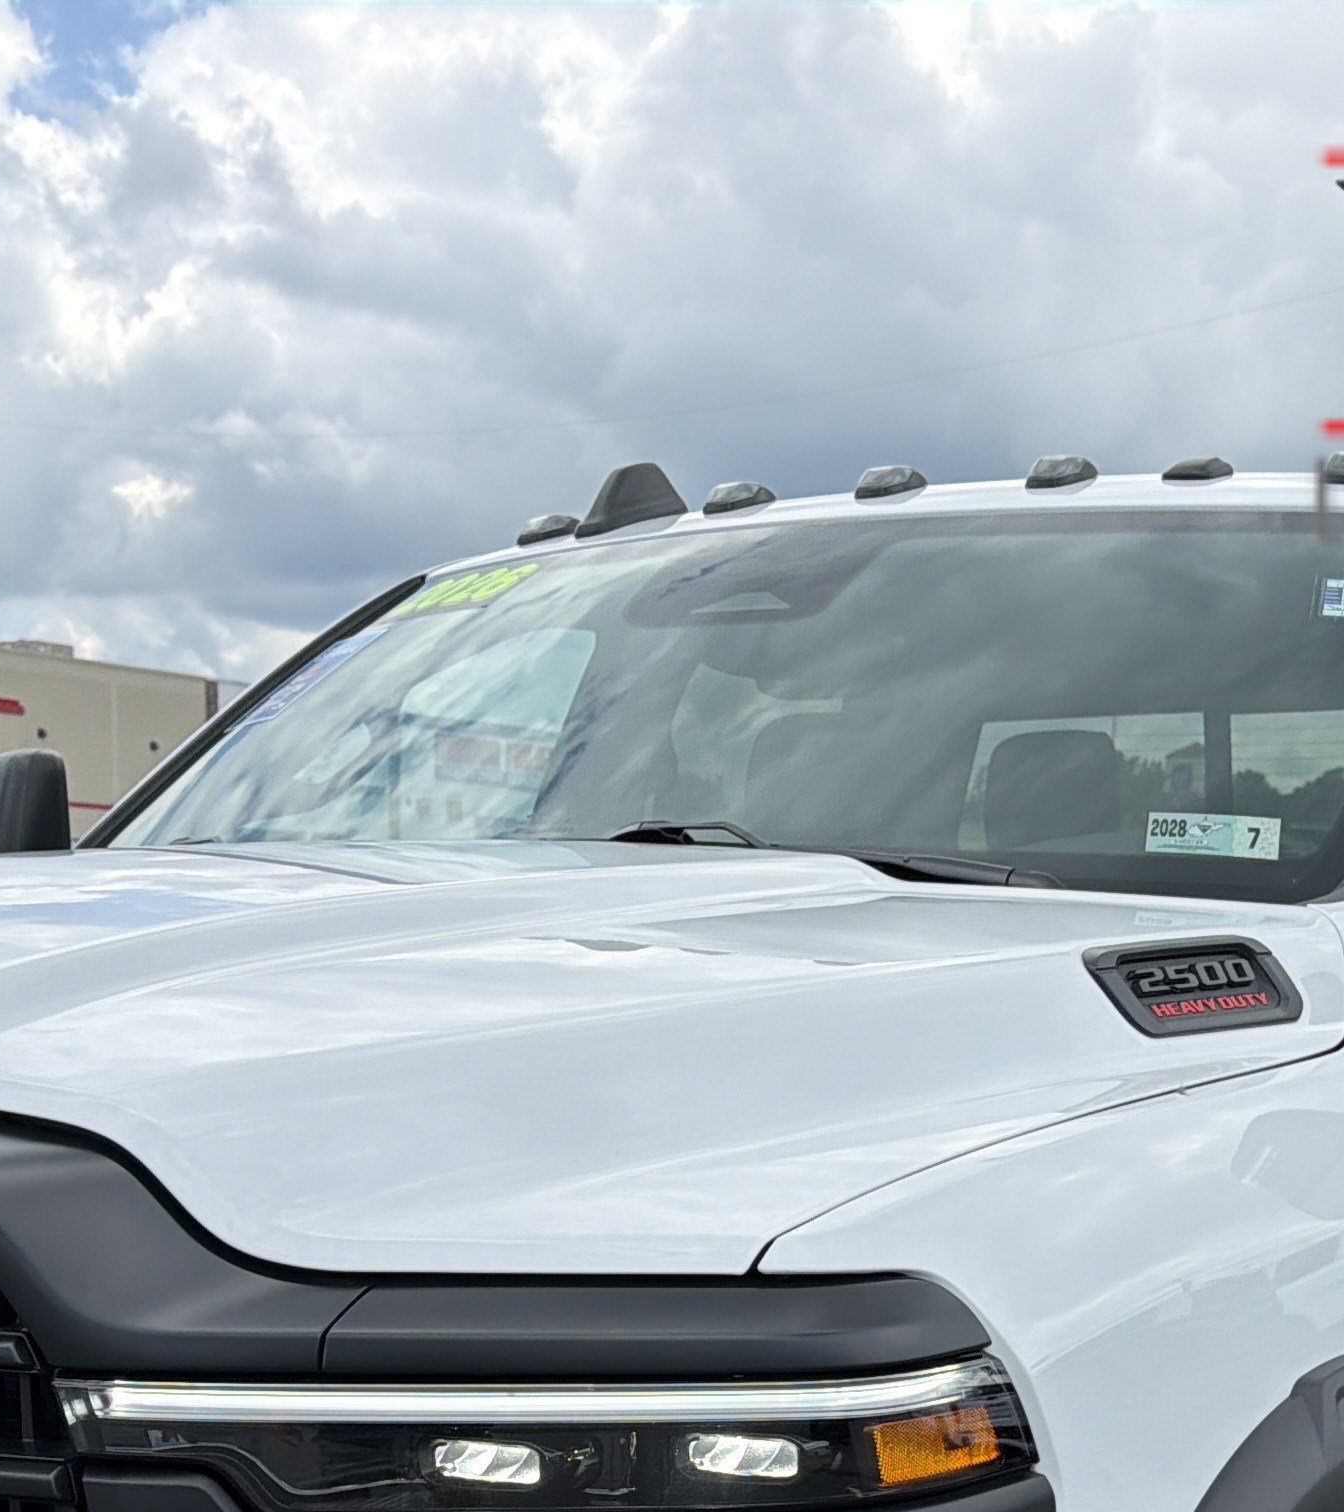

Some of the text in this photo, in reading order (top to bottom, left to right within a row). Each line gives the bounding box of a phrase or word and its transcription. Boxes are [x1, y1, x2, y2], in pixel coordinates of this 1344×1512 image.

[1150, 817, 1261, 850] 2028 7
[1130, 957, 1256, 998] 2500
[1150, 991, 1270, 1018] HEAVY DUTY
